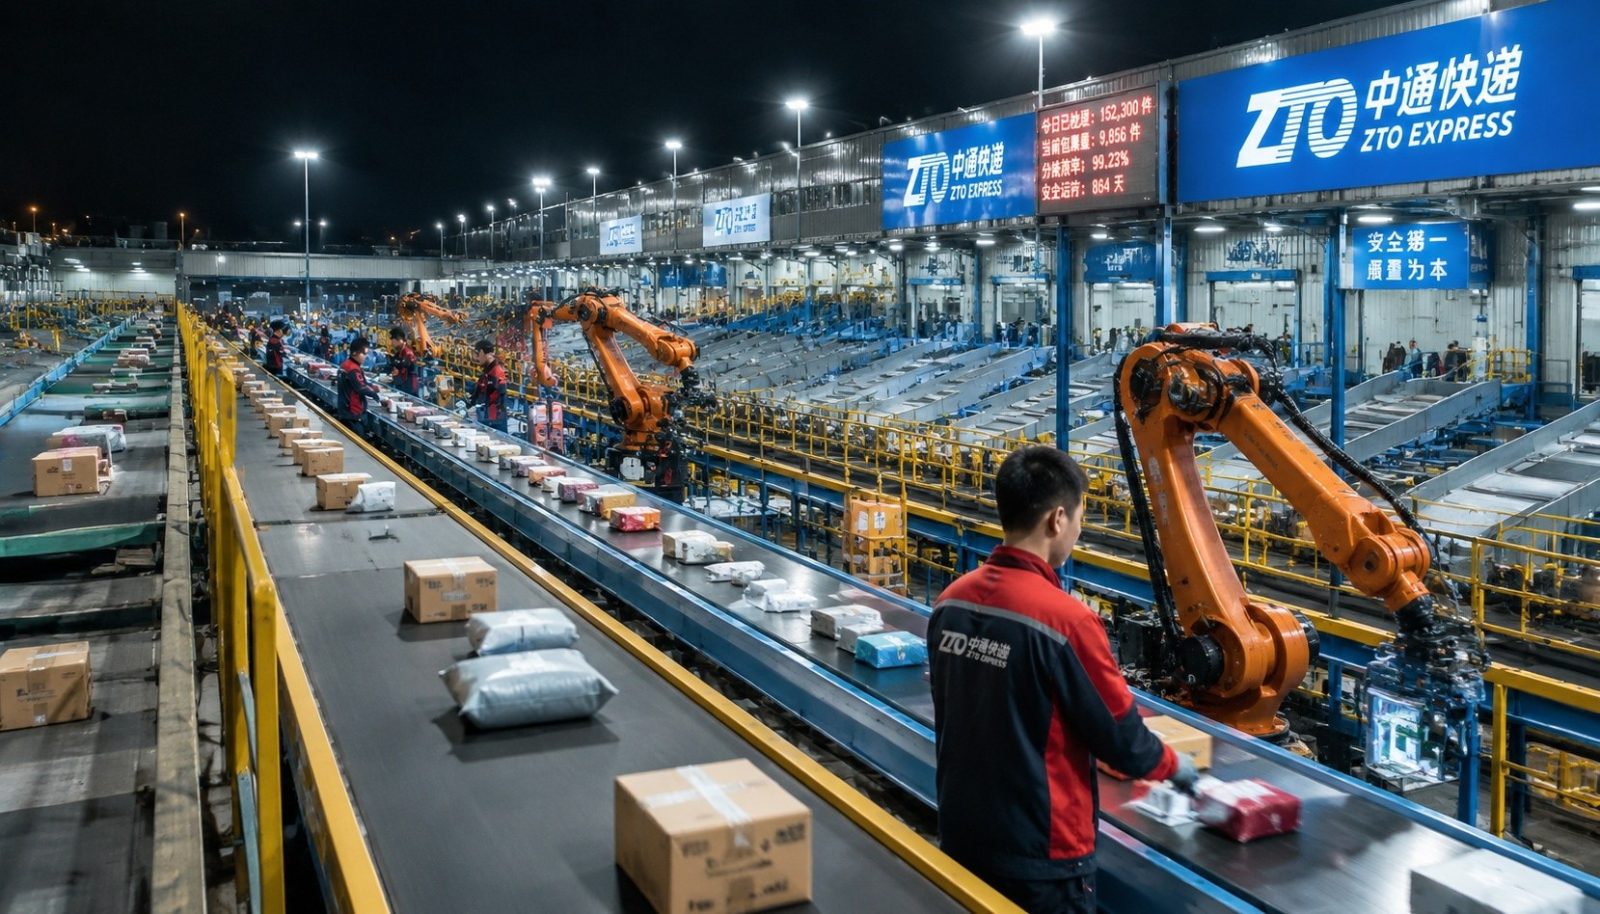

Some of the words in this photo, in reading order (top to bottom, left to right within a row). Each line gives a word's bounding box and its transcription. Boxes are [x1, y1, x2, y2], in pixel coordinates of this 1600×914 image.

[1365, 44, 1523, 120] 中通快递
[1100, 100, 1138, 122] 152,300
[1141, 96, 1152, 115] 件
[1099, 127, 1127, 146] 9,856
[1130, 122, 1140, 142] 件
[1236, 79, 1357, 168] ZTO
[1360, 125, 1403, 152] ZTO
[1408, 110, 1516, 146] EXPRESS
[952, 141, 1004, 180] 中通快递
[1092, 150, 1129, 170] 99.23%
[903, 152, 950, 207] ZTO
[950, 184, 966, 200] ZTO
[968, 180, 1003, 198] EXPRESS
[1092, 178, 1110, 194] 864
[1114, 174, 1124, 192] 天
[939, 629, 968, 655] ZTO
